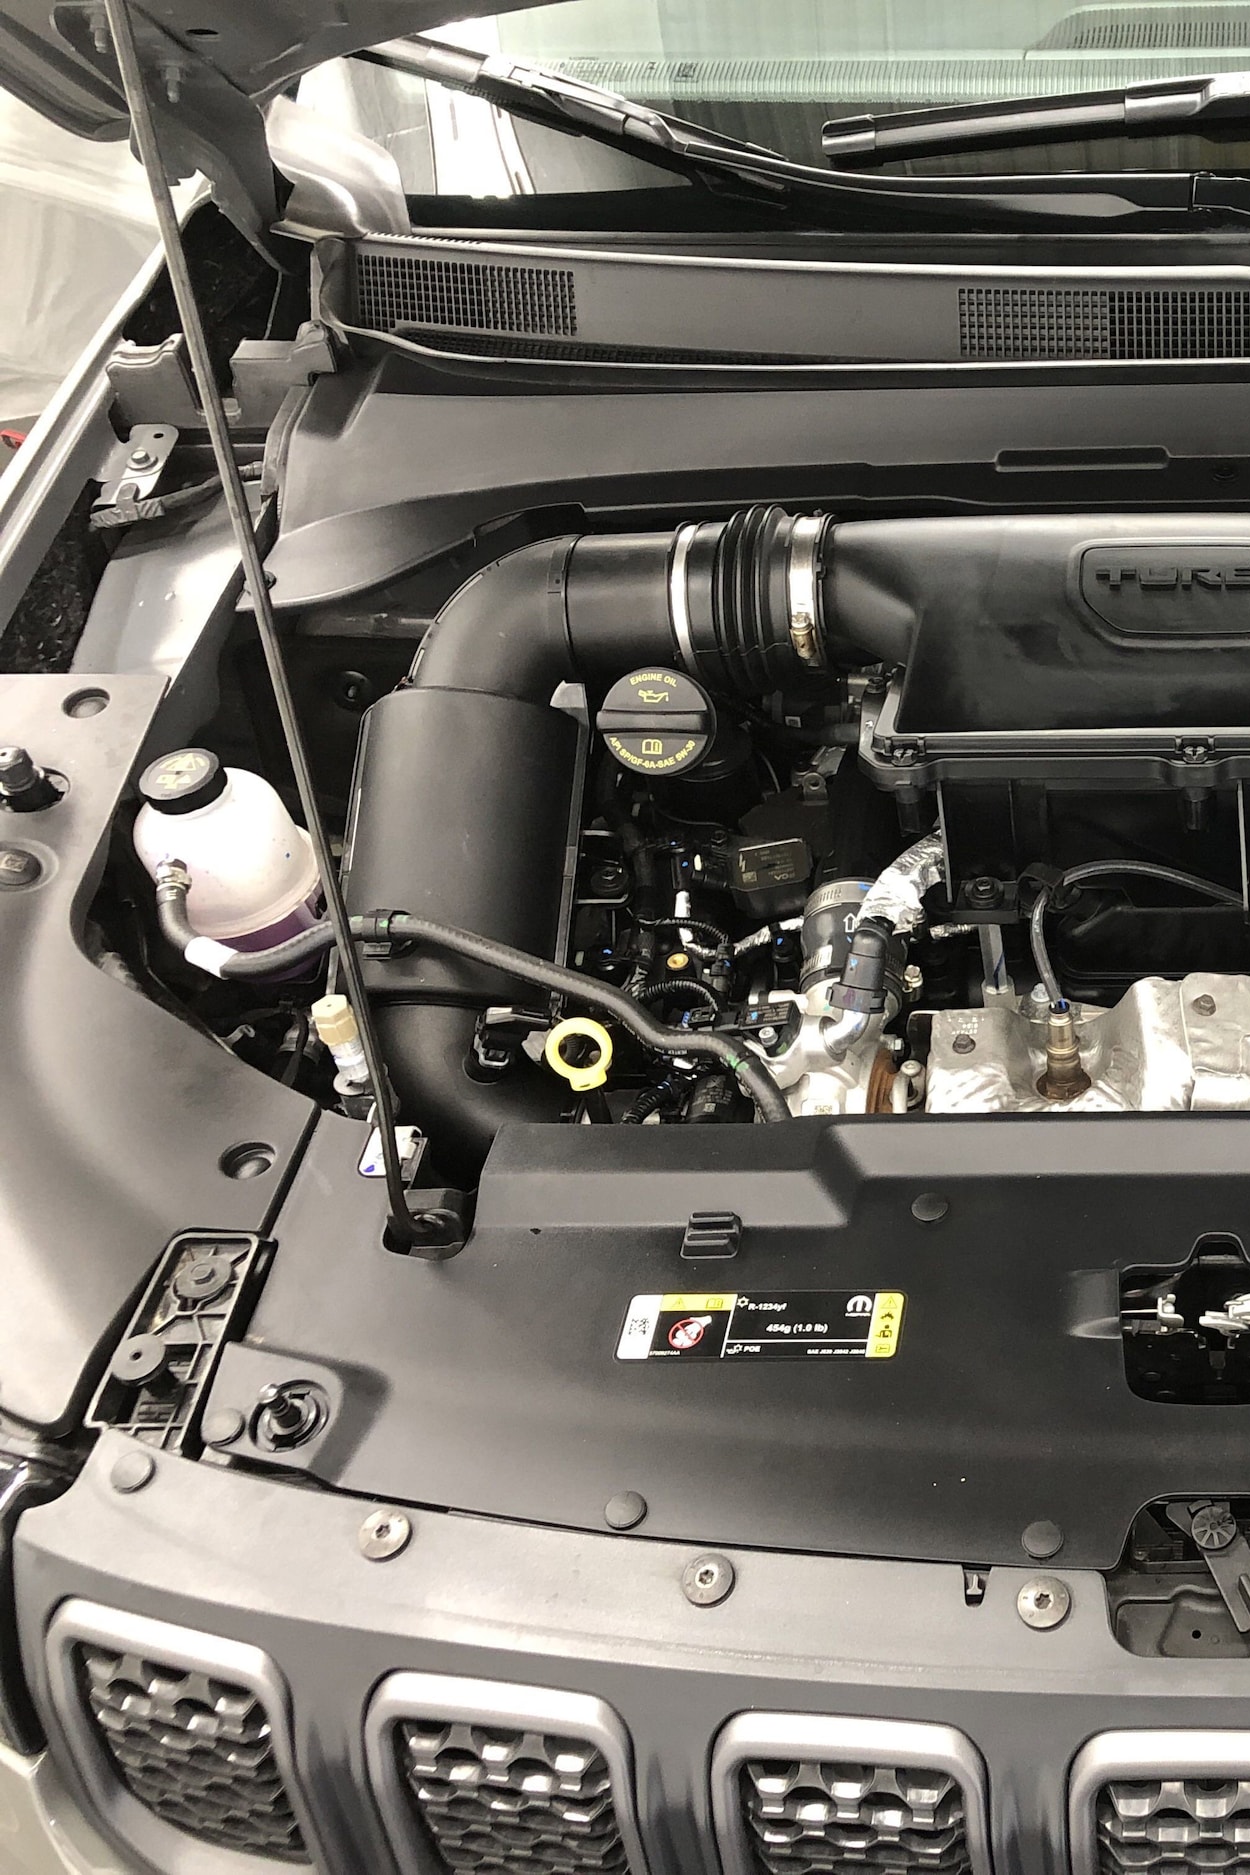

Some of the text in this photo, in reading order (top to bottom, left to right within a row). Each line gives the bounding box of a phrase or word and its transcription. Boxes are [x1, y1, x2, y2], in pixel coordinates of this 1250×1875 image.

[629, 673, 677, 687] ENGINE OIL
[609, 737, 622, 751] API
[675, 740, 696, 761] 5W-30
[748, 1302, 787, 1312] R-1234yf
[766, 1323, 828, 1334] 454g (1.0 lb)
[743, 1345, 761, 1353] POE
